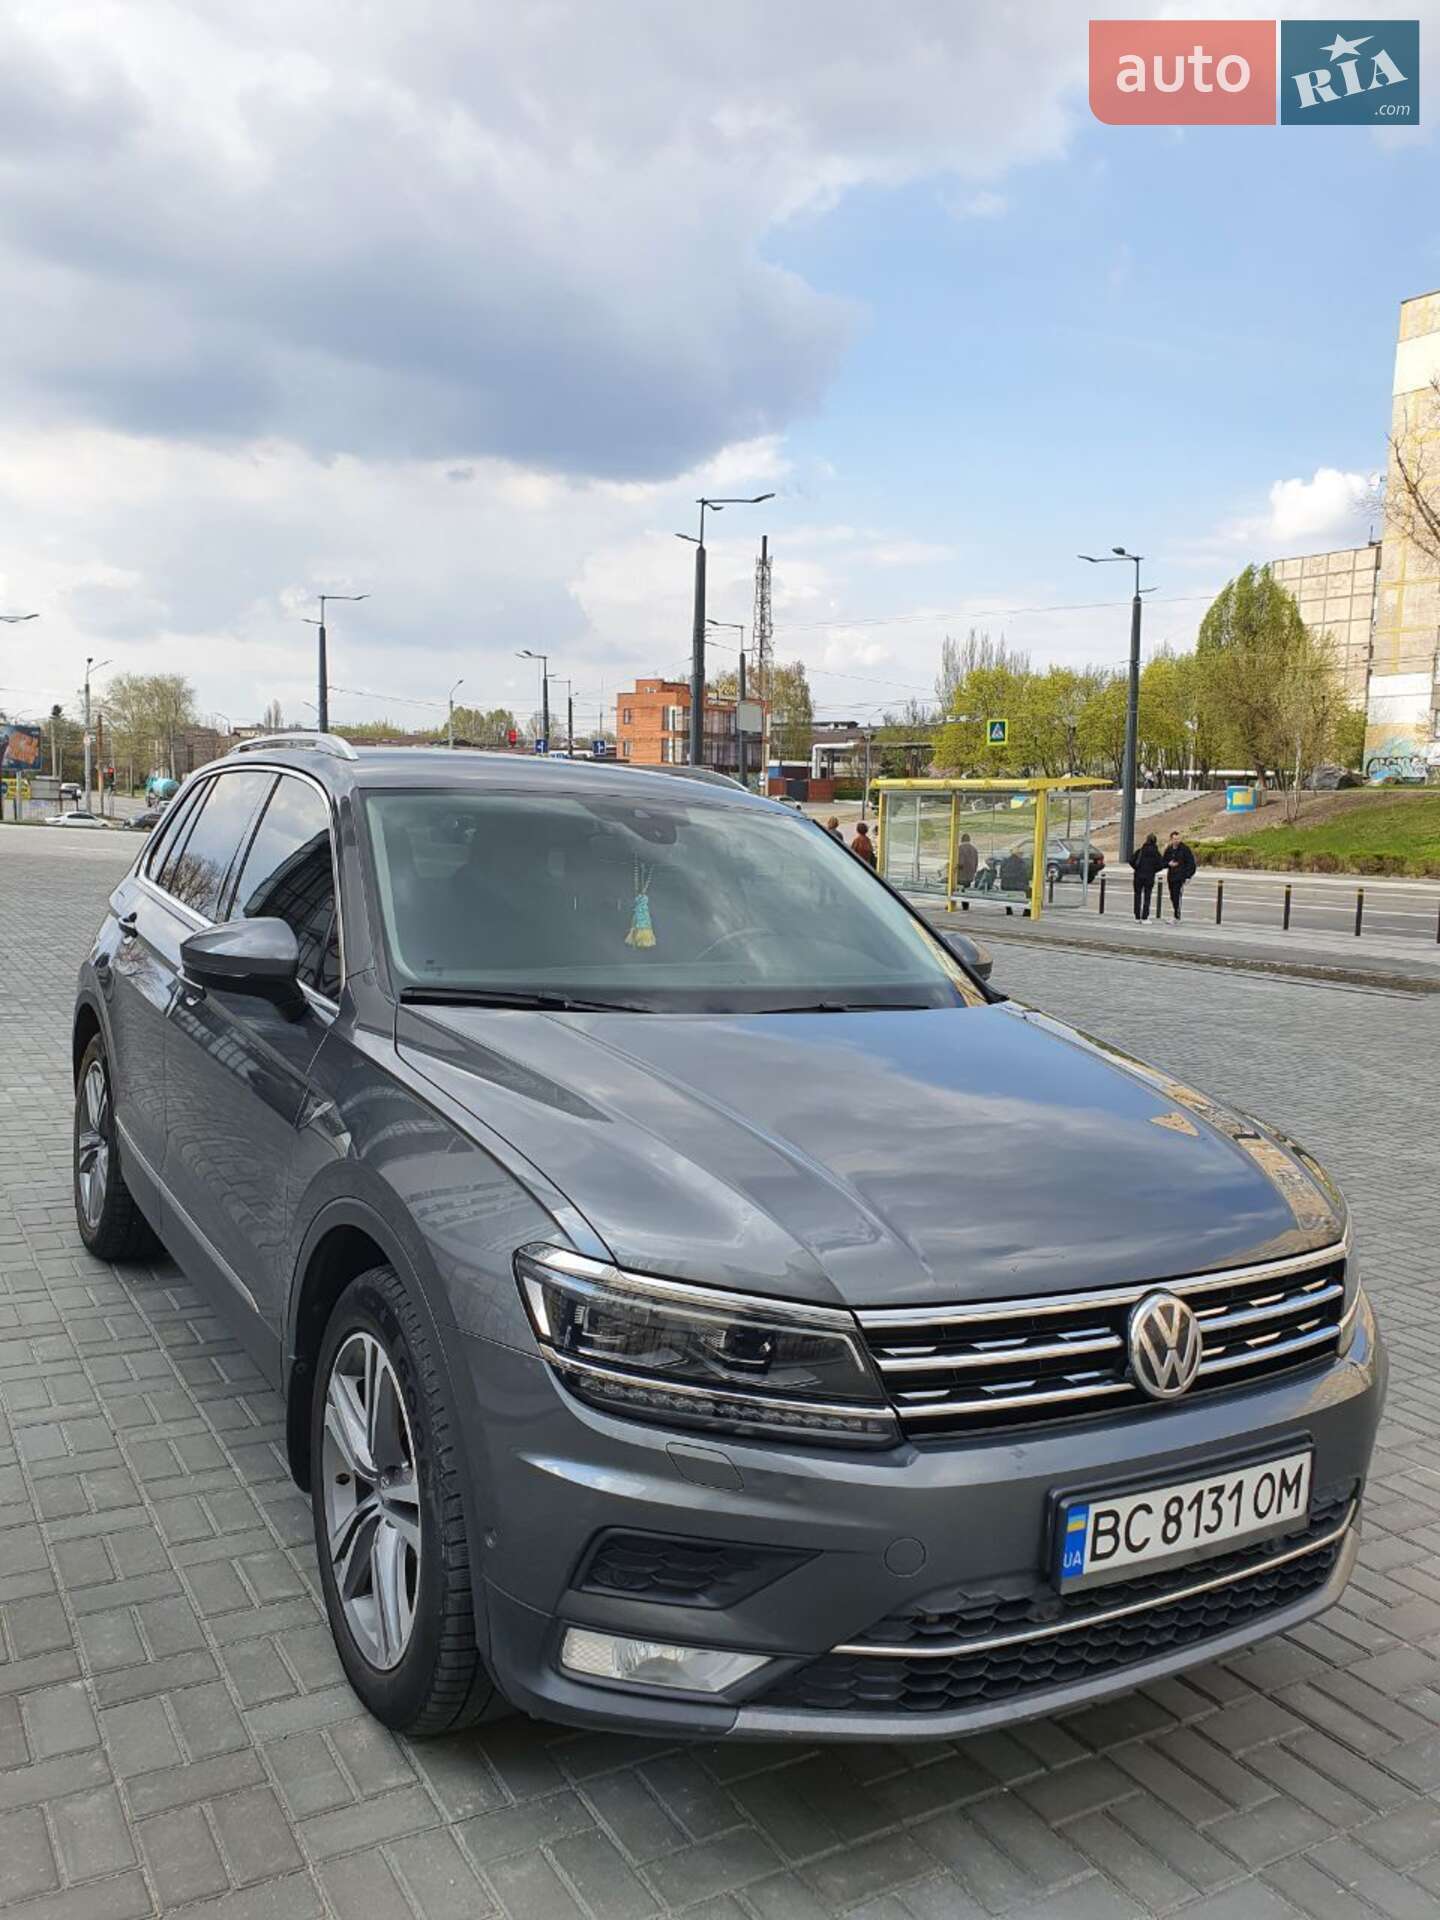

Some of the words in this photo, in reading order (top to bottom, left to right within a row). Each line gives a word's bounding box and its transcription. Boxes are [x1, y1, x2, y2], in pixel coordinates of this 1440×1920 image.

[1089, 1503, 1153, 1562] BC
[1161, 1479, 1244, 1545] 8131
[1253, 1463, 1303, 1519] OM
[1062, 1551, 1082, 1569] UA
